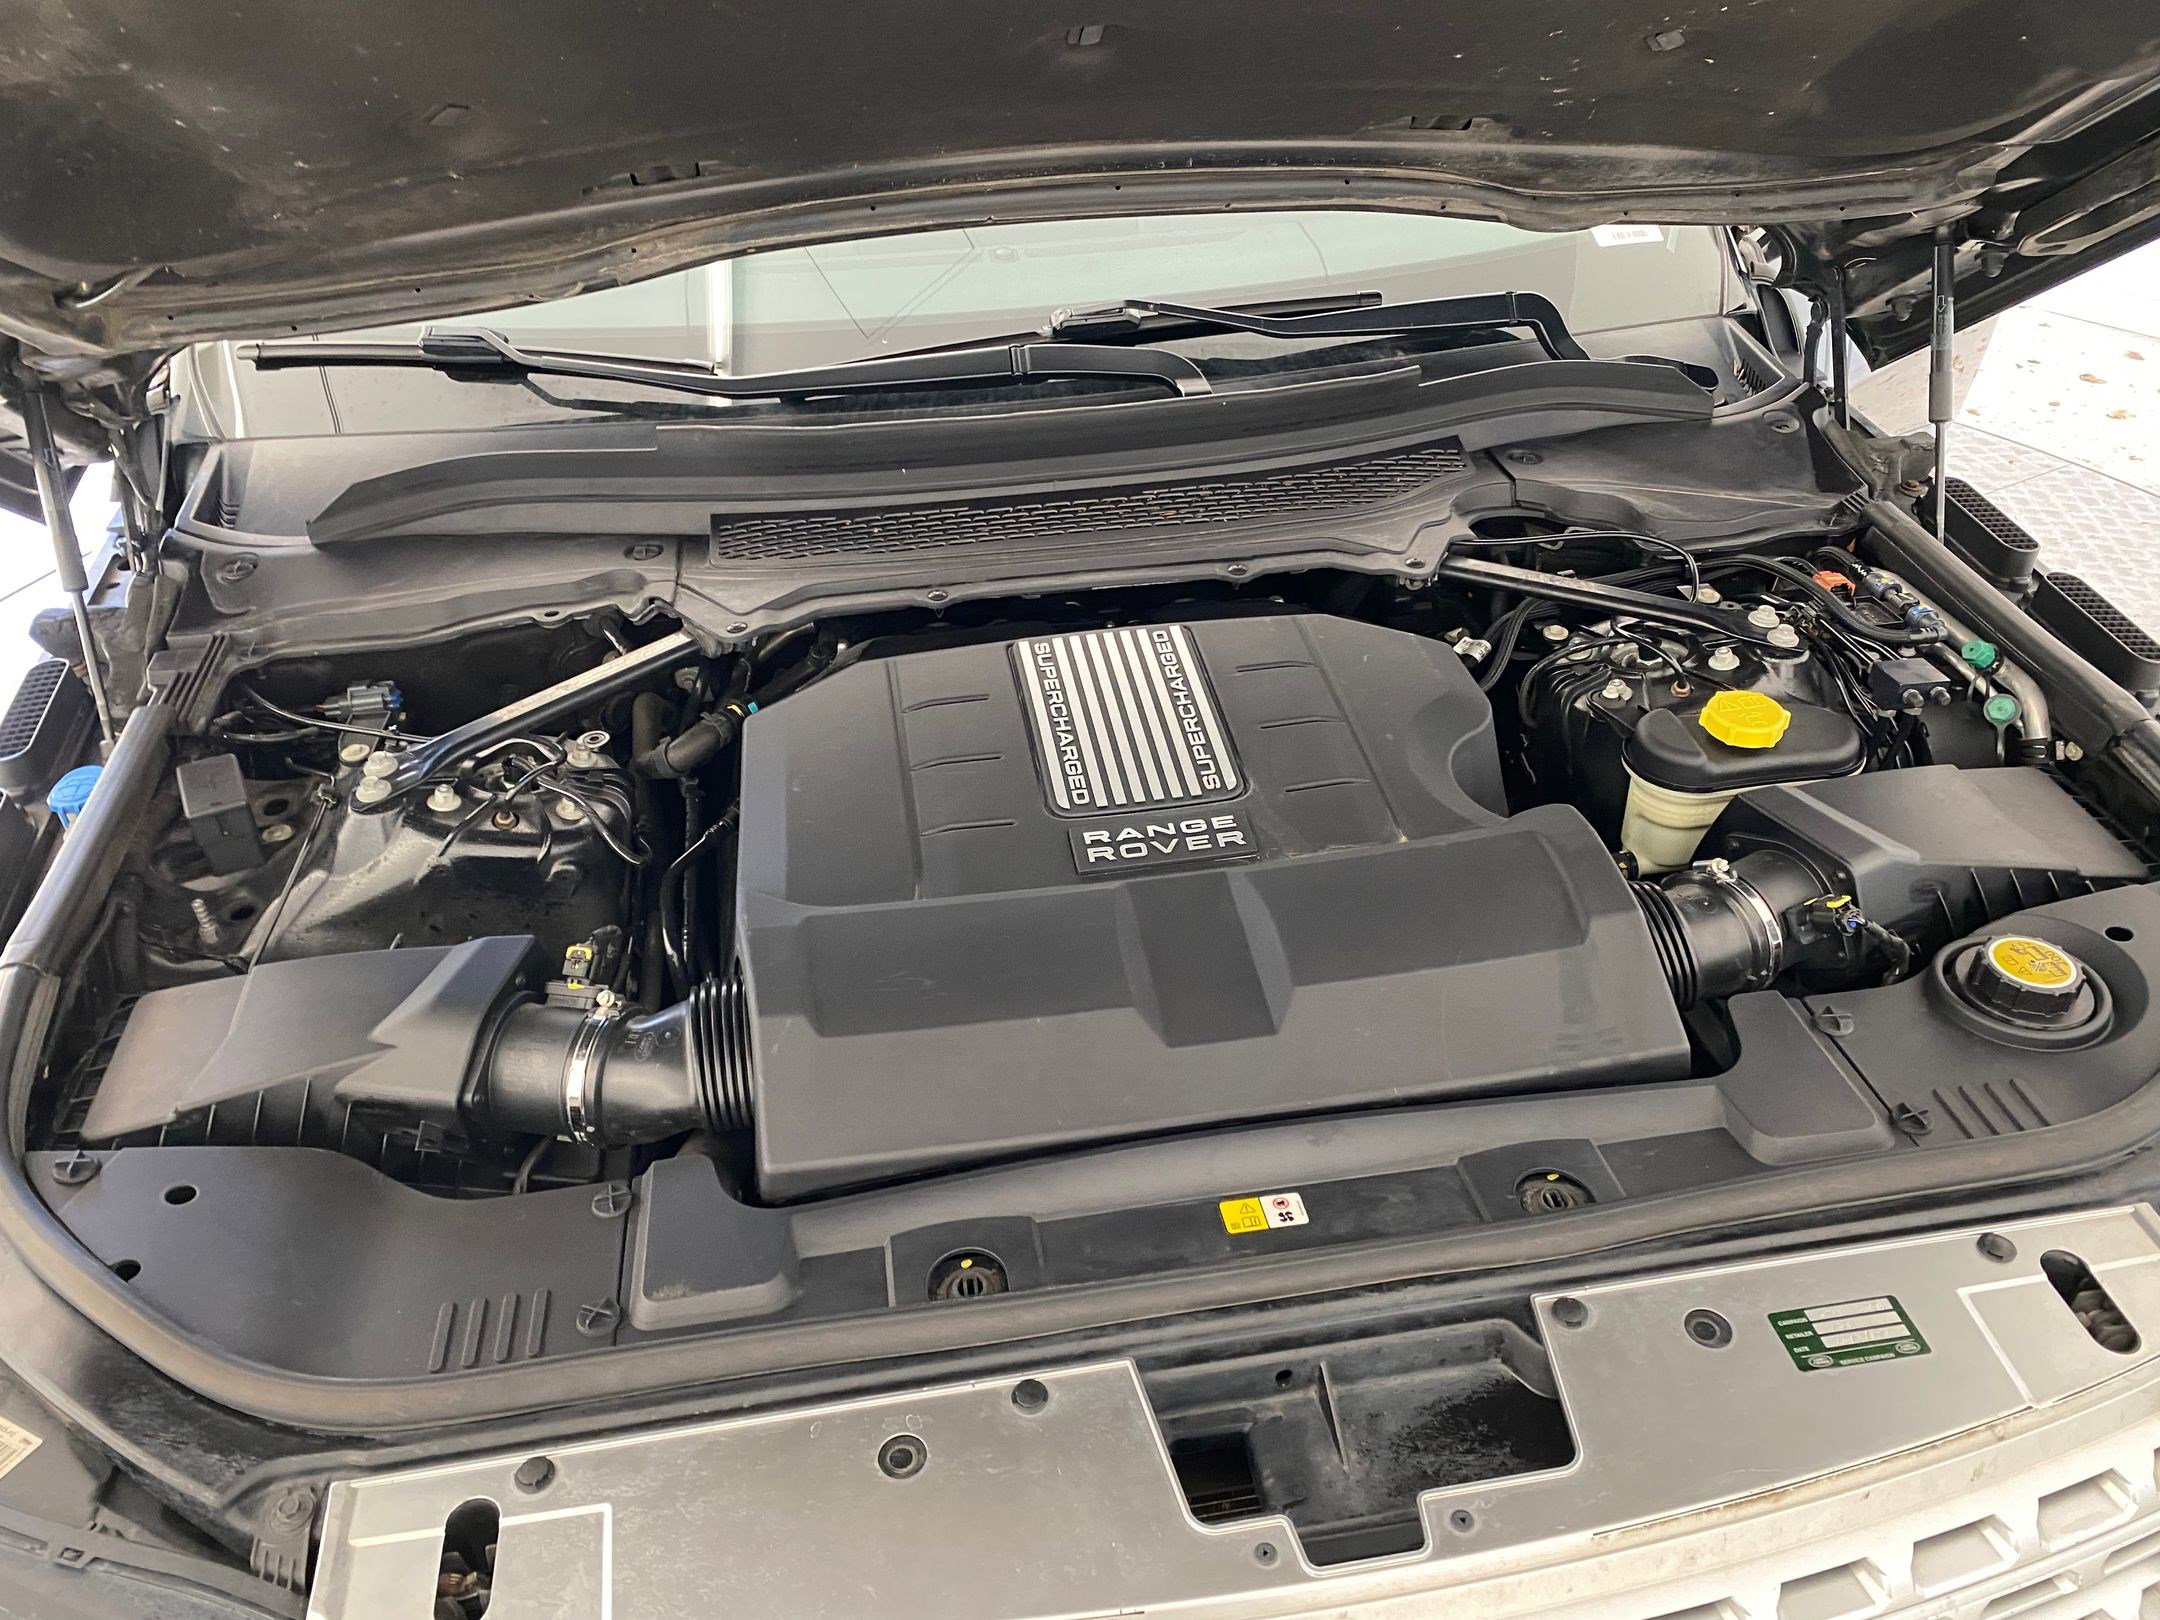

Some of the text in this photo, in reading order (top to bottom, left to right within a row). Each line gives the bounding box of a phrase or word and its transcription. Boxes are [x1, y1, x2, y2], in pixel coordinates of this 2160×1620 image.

[1034, 641, 1090, 805] SUPERCHARGED
[1152, 630, 1221, 790] SUPERCHARGED
[1082, 815, 1237, 845] RANGE
[1086, 830, 1247, 863] ROVER
